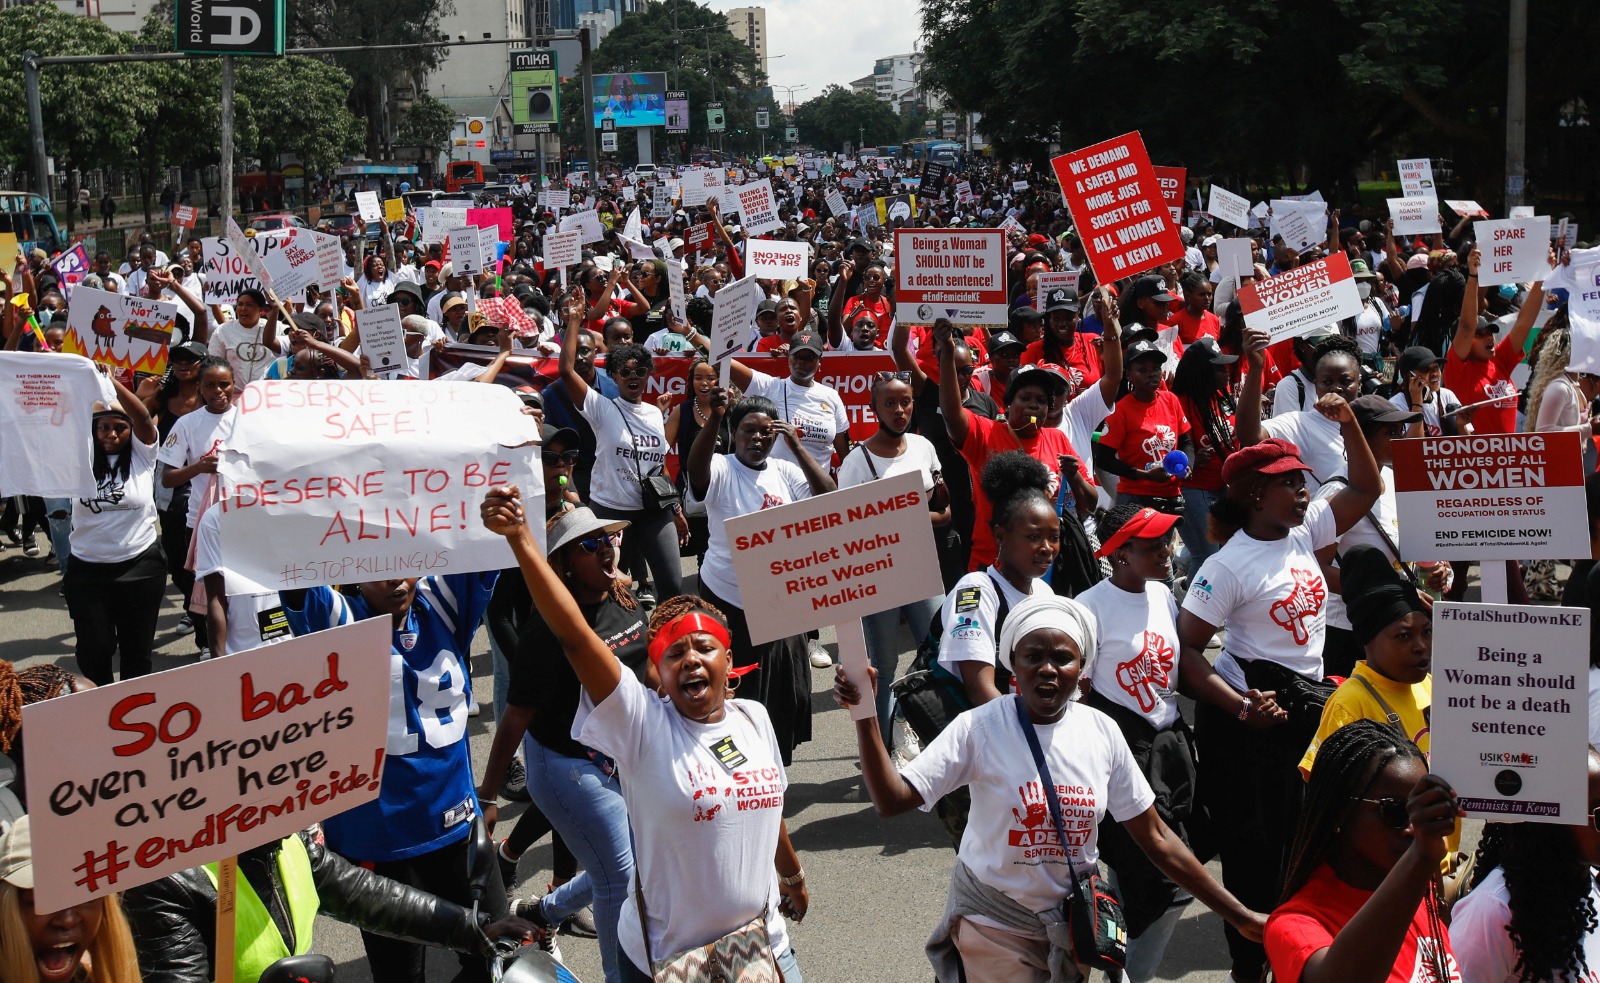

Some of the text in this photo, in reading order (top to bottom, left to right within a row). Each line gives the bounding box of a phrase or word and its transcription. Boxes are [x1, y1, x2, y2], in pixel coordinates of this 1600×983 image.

[191, 0, 203, 43] World
[517, 54, 550, 66] MIKA
[1069, 145, 1130, 175] WE DEMAND
[1076, 162, 1138, 194] A SAFER AND
[739, 189, 760, 199] BEING
[741, 192, 769, 205] WOMAN
[1085, 191, 1116, 211] MORE
[1117, 181, 1141, 201] JUST
[743, 199, 769, 210] SHOULD
[745, 204, 770, 216] NOT BE
[745, 217, 776, 229] SENTENCE
[752, 211, 772, 221] DEATH
[1090, 206, 1130, 230] SOCIETY
[1131, 199, 1152, 217] FOR
[1092, 216, 1166, 254] ALL WOMEN
[1494, 228, 1525, 240] SPARE
[284, 244, 298, 257] SAY
[912, 236, 987, 253] Being a Woman
[1494, 246, 1513, 257] HER
[286, 249, 306, 261] THEIR
[290, 249, 316, 269] NAMES!
[752, 251, 802, 260] SOMEONE
[754, 258, 777, 266] WAS
[916, 254, 985, 268] SHOULD NOT be
[1112, 242, 1163, 271] IN KENYA
[1254, 260, 1327, 293] HONORING
[1494, 262, 1513, 273] LIFE
[908, 273, 994, 287] a death sentence!
[1257, 269, 1330, 299] THE LIVES OF ALL
[922, 291, 981, 302] #EndFemicideKE
[1259, 275, 1331, 308] WOMEN
[124, 297, 143, 308] THIS
[1268, 290, 1331, 317] REGARDLESS OF
[131, 307, 153, 318] NOT
[1269, 306, 1305, 320] OCCUPATION
[1269, 324, 1285, 333] END
[1286, 311, 1319, 328] FEMICIDE
[1319, 304, 1340, 317] NOW!
[239, 381, 386, 415] DESERVE
[1422, 436, 1546, 457] HONORING
[1424, 455, 1547, 469] THE LIVES OF ALL
[235, 470, 385, 509] DESERVE
[403, 468, 449, 496] TO
[463, 461, 512, 487] BE
[1427, 466, 1546, 490] WOMEN
[1436, 496, 1544, 509] REGARDLESS OF
[735, 491, 920, 551] SAY THEIR NAMES
[1437, 510, 1496, 519] OCCUPATION
[1512, 508, 1546, 517] STATUS
[319, 500, 466, 546] ALIVE!
[1435, 528, 1552, 540] END FEMICIDE NOW!
[769, 532, 901, 576] Starlet Wahu
[279, 550, 449, 587] #STOPKILLINGUS
[785, 553, 894, 595] Rita Waeni
[811, 583, 877, 611] Malkia
[1440, 608, 1582, 627] #TotalShutDownKE
[1477, 646, 1542, 667] Being a
[1444, 669, 1575, 690] Woman should
[107, 652, 348, 757] So bad
[1447, 695, 1571, 714] not be a death
[1471, 720, 1546, 737] sentence
[49, 706, 354, 816] even introverts
[732, 767, 779, 785] STOP
[114, 750, 328, 828] are here
[1087, 787, 1095, 795] A
[1058, 796, 1096, 808] OMAN
[1459, 799, 1558, 816] Feminists in Kenya
[72, 747, 385, 893] #endFemicide!
[1076, 820, 1090, 830] BE
[1018, 832, 1032, 846] A
